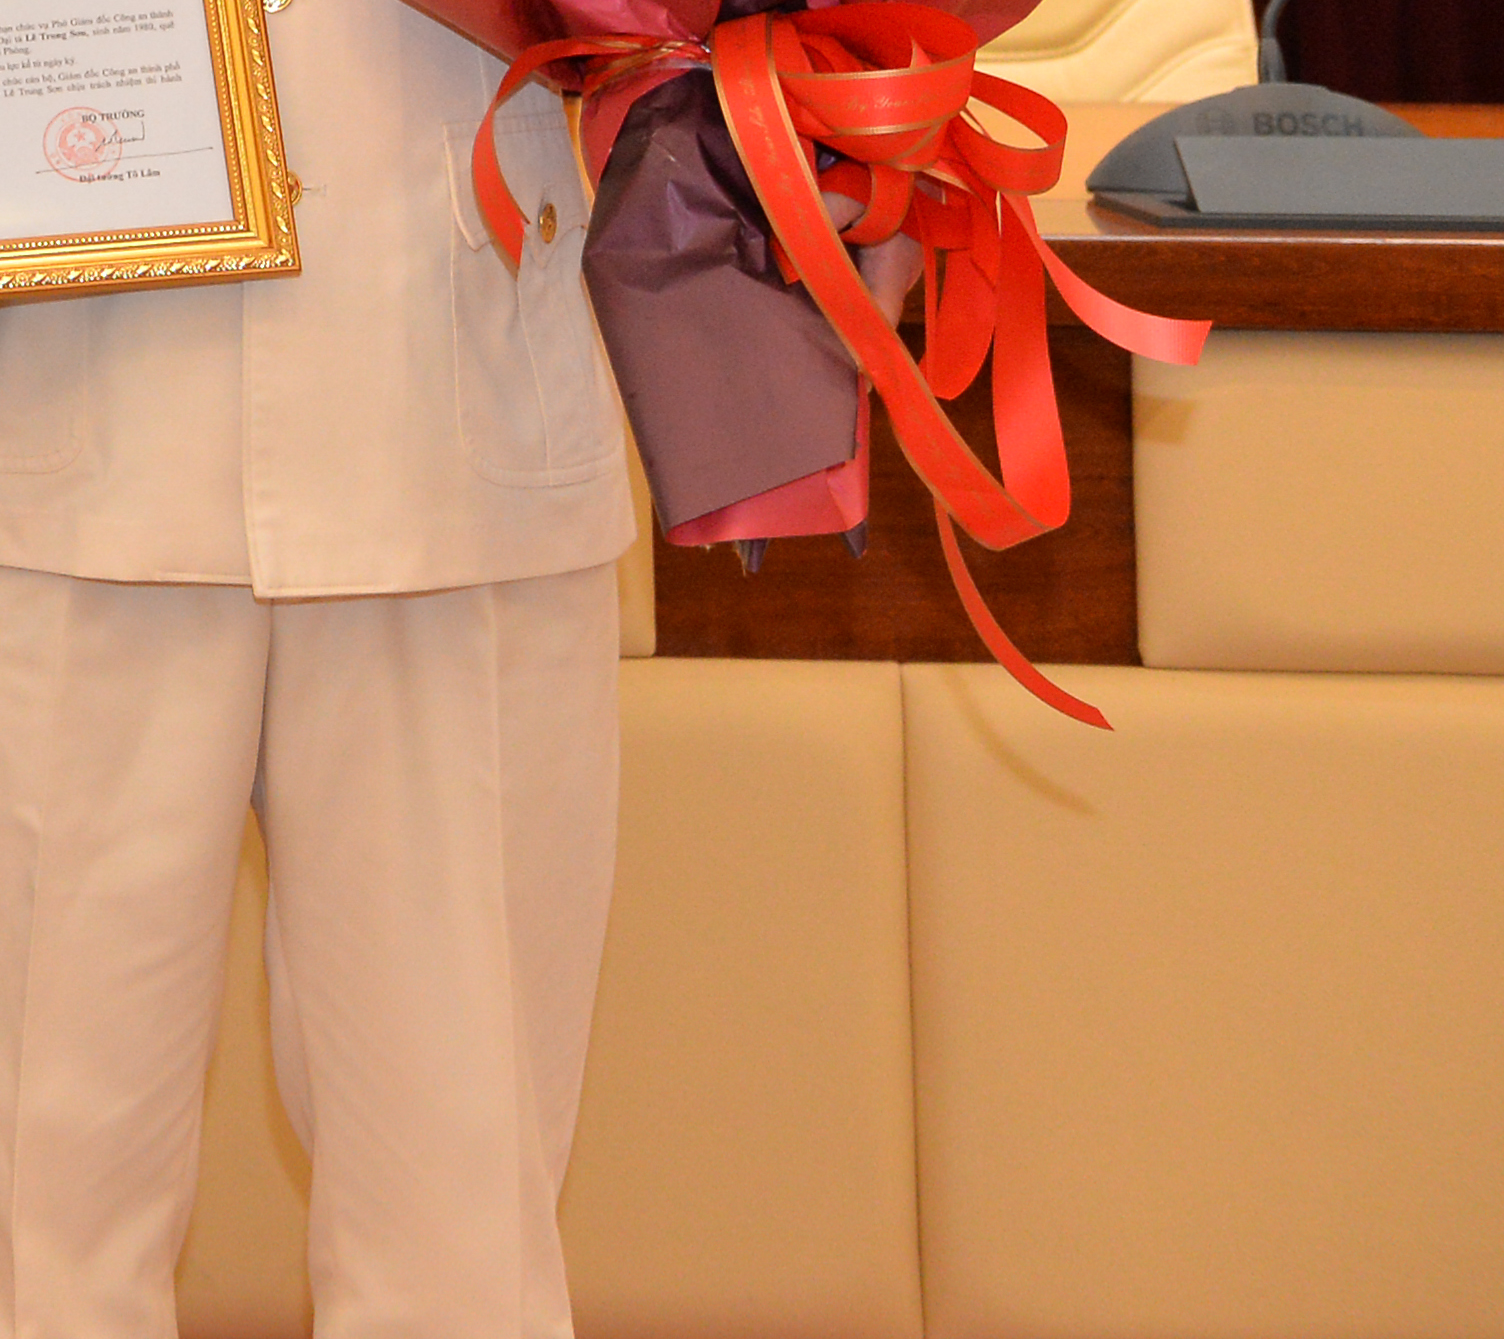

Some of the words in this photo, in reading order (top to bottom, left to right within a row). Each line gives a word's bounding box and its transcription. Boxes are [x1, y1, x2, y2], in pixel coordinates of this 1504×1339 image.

[80, 112, 98, 124] BỘ
[97, 107, 145, 122] TRƯỞNG
[1253, 112, 1363, 137] BOSCH
